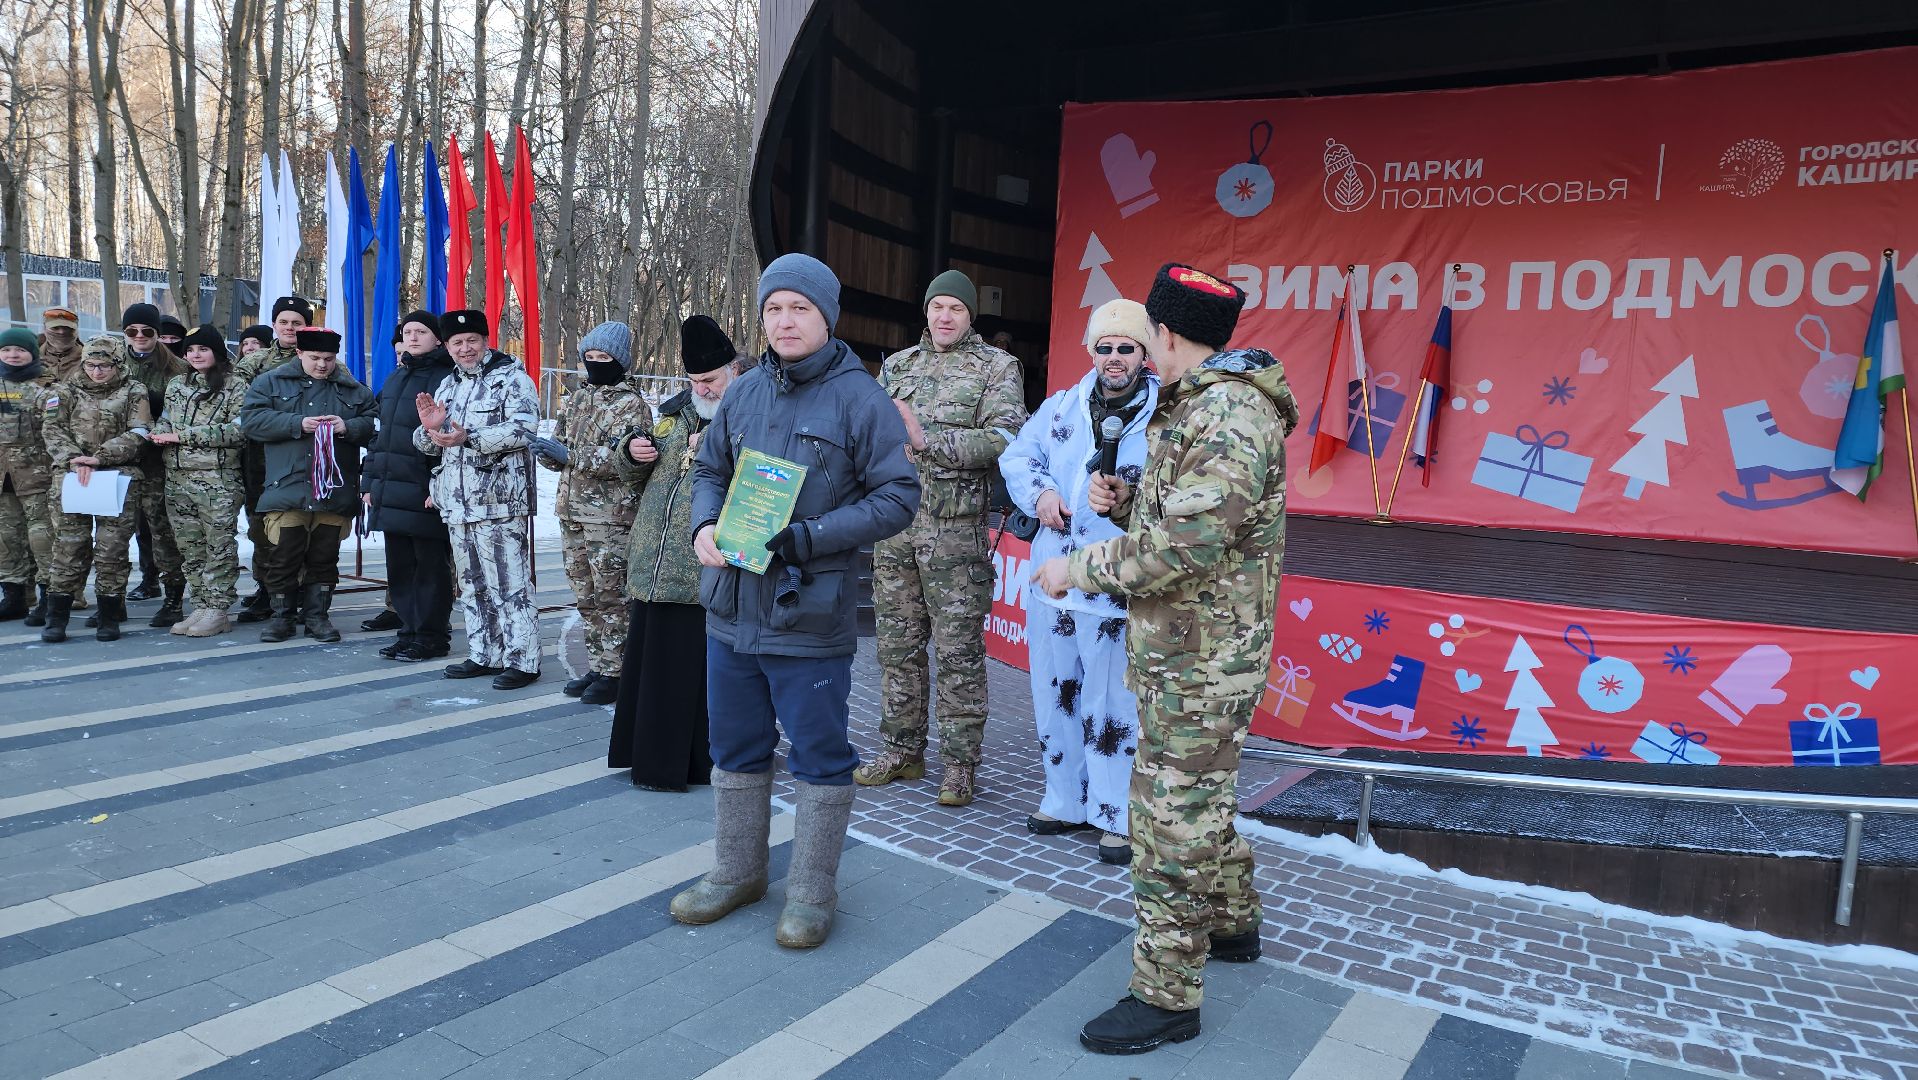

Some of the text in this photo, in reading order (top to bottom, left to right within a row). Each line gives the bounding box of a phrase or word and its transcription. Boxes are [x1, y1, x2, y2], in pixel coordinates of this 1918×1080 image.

[1799, 139, 1918, 161] ГОРОДСК
[1383, 158, 1483, 182] ПАРКИ
[1381, 178, 1629, 209] ПОДМОСКОВЬЯ
[1699, 183, 1736, 192] КАШИРА
[1227, 261, 1419, 311] ЗИМА
[1441, 262, 1486, 311] В
